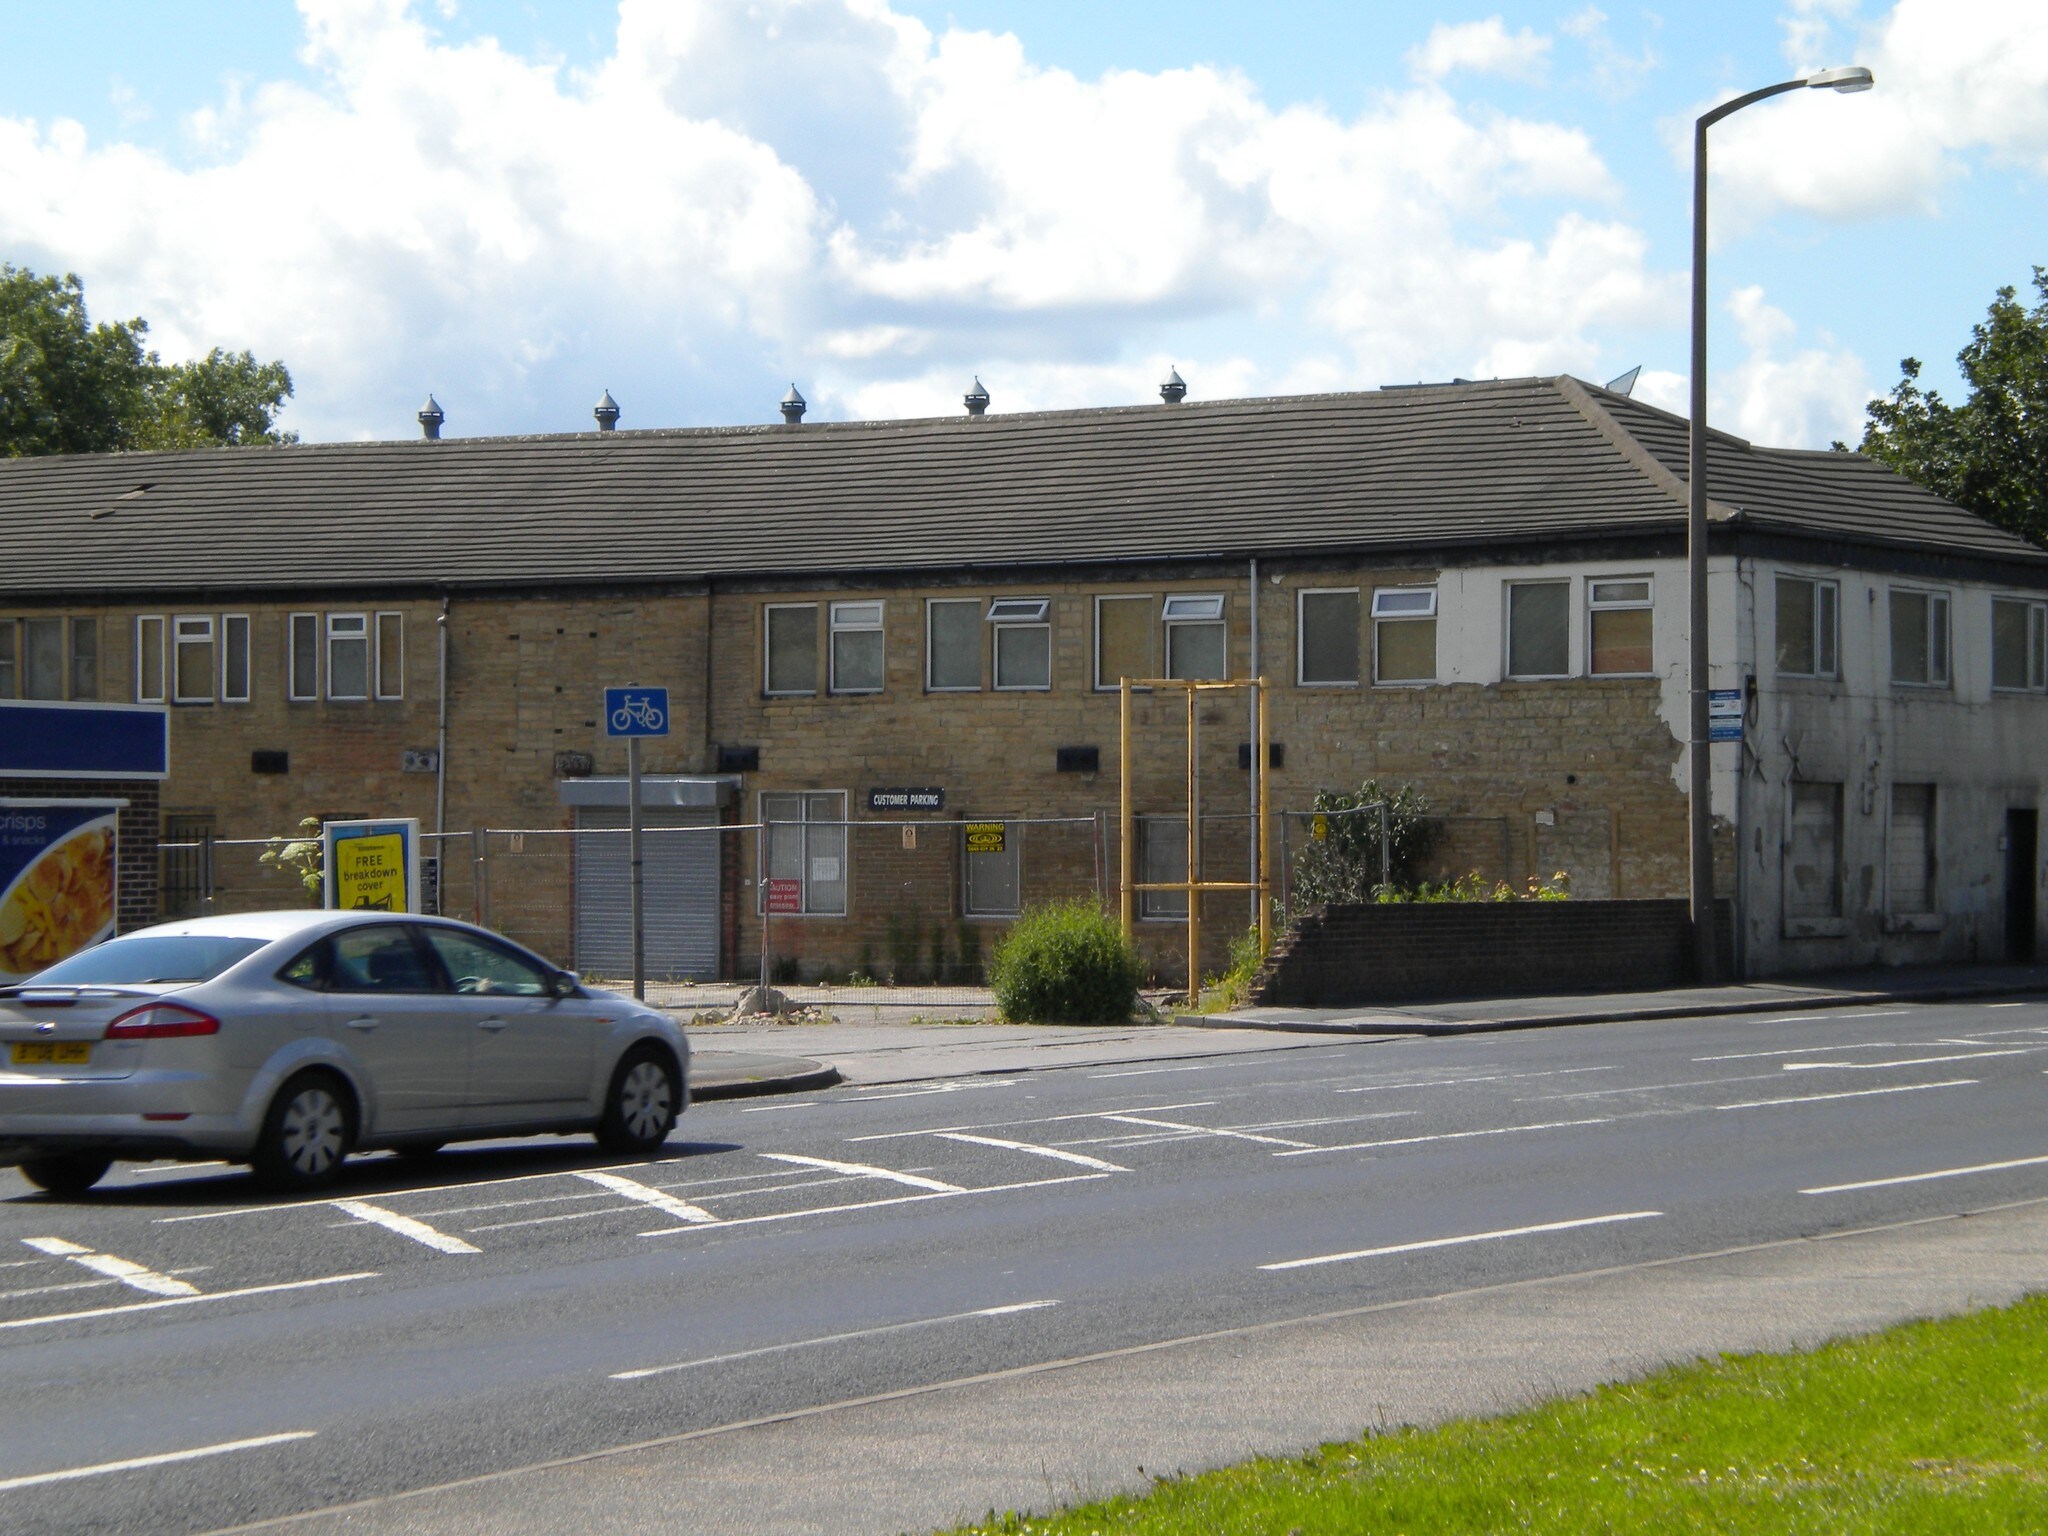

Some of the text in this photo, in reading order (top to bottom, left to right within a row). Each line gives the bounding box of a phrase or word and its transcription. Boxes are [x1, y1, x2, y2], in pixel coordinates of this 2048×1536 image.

[873, 794, 939, 806] CUSTOMER PARKING
[966, 823, 1005, 831] WARNING
[356, 855, 382, 867] FREE
[343, 867, 397, 881] breakdown
[356, 881, 384, 892] cover
